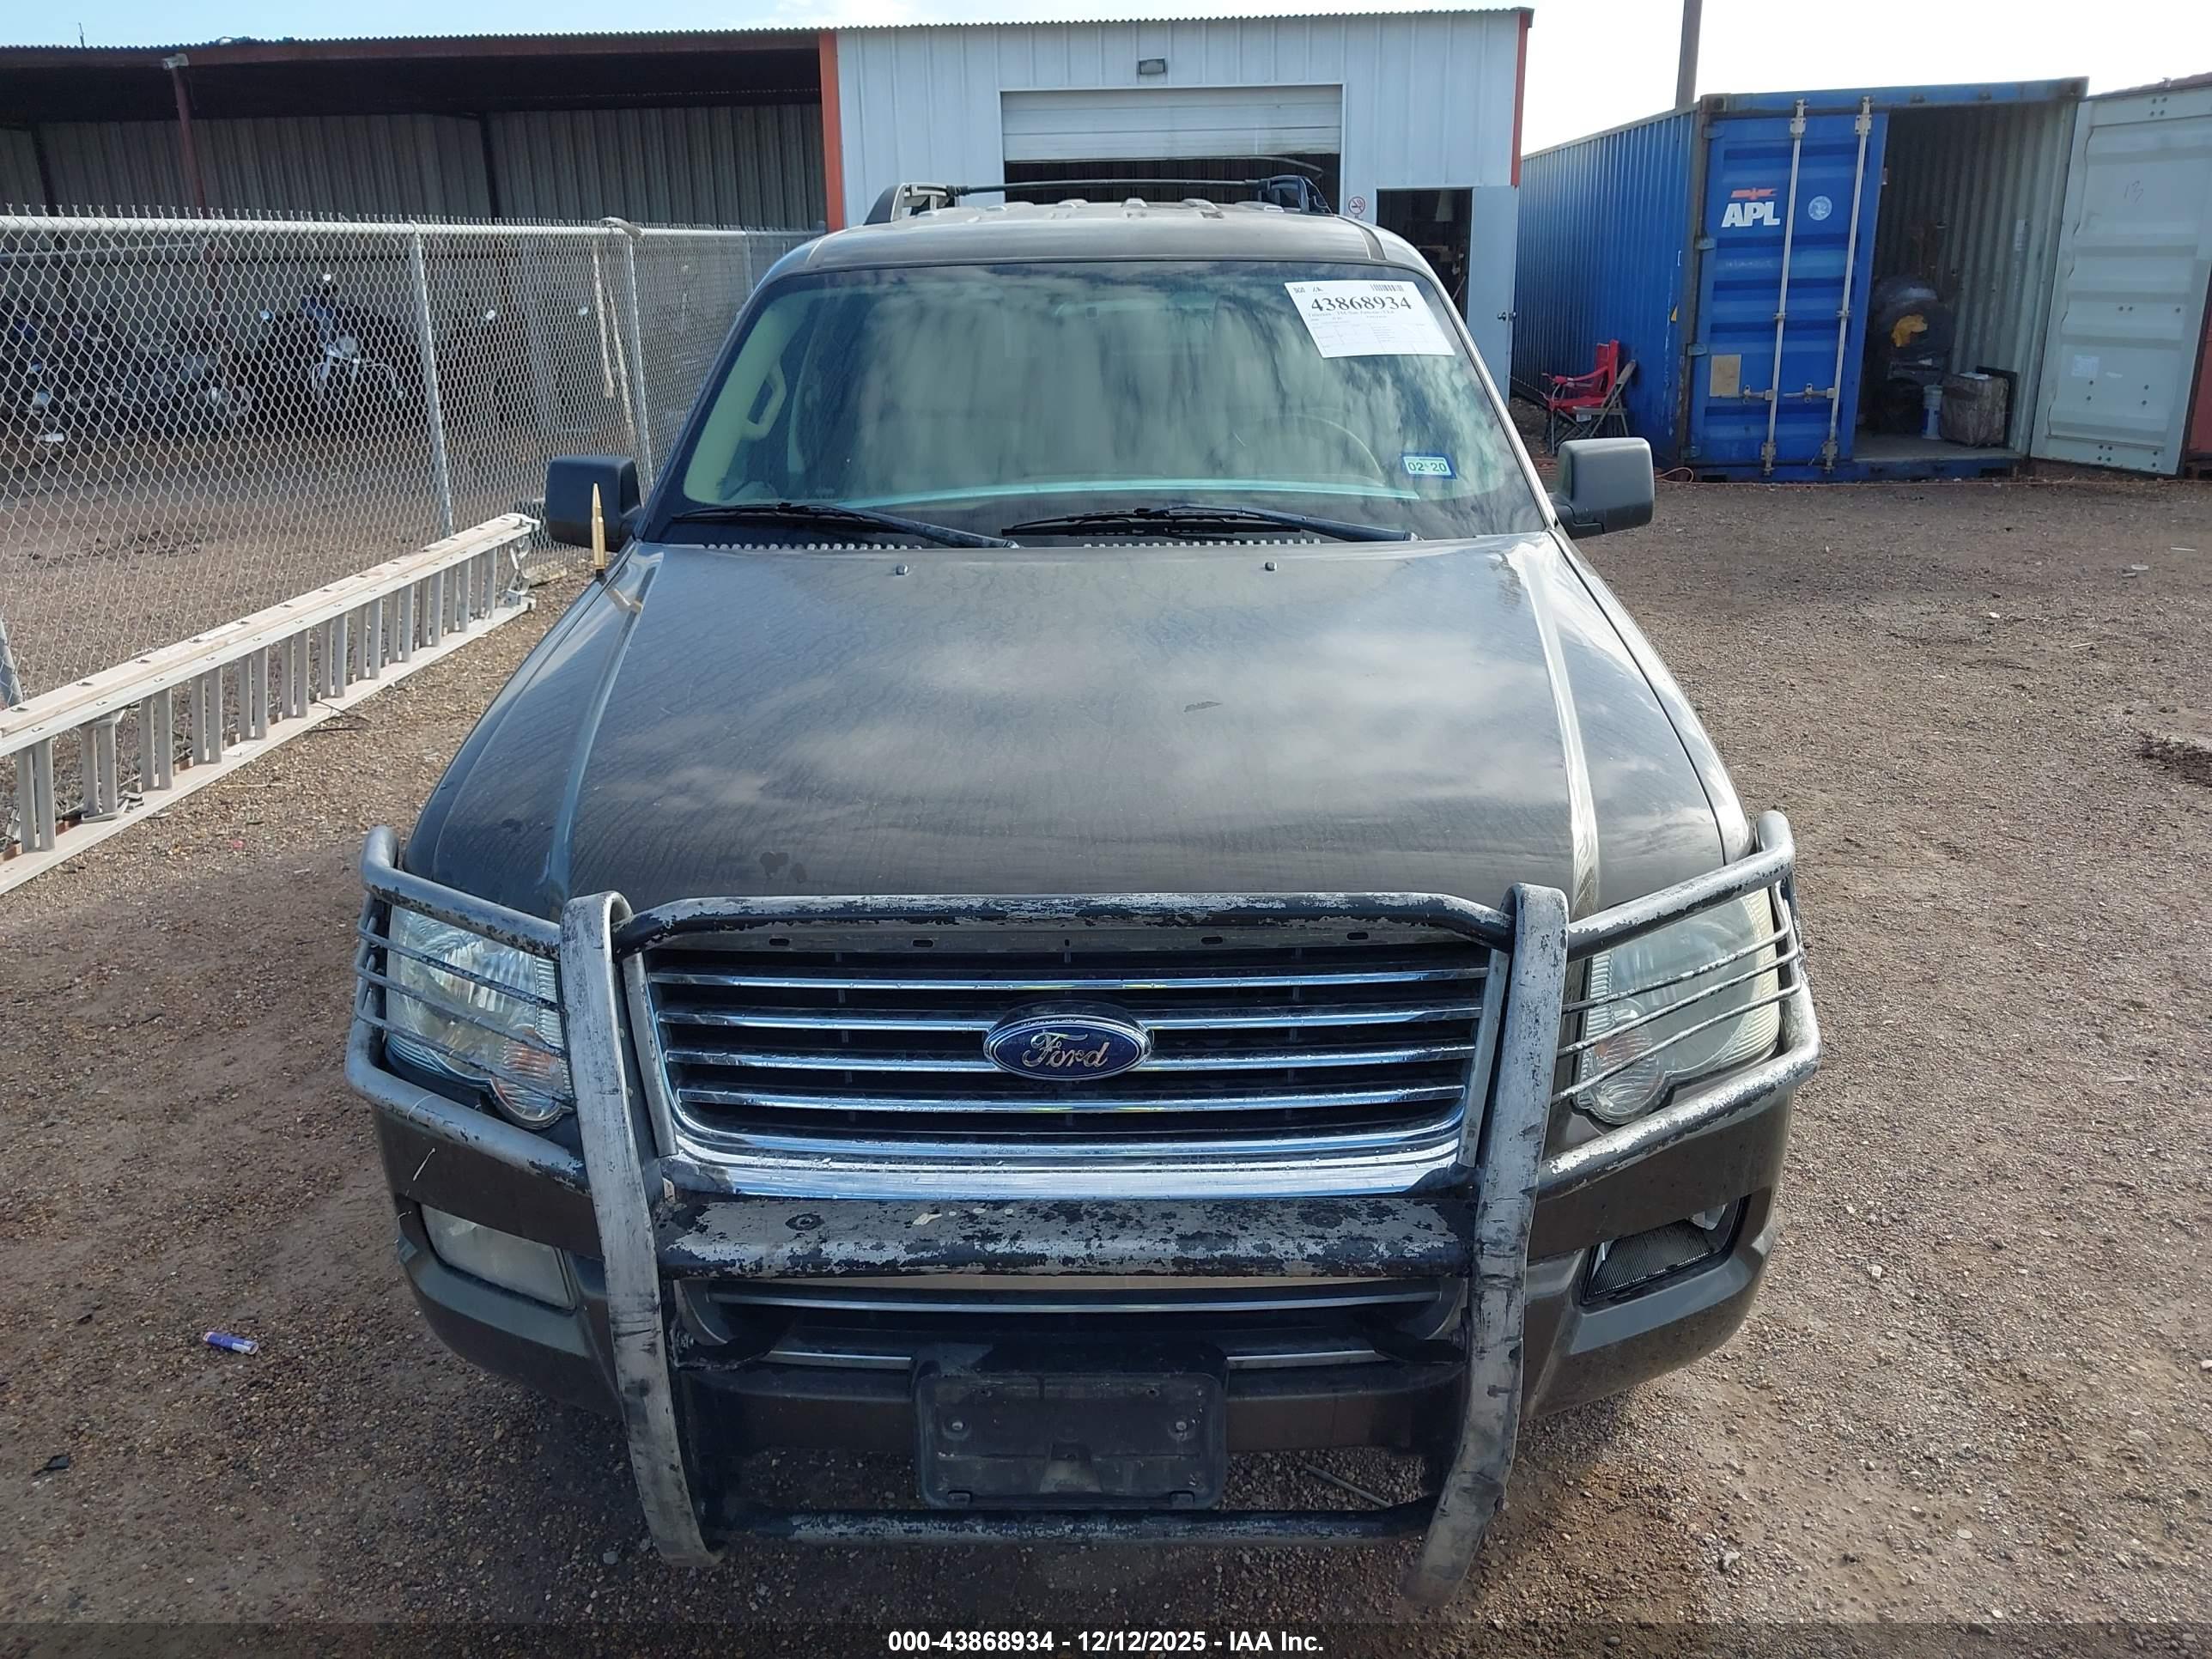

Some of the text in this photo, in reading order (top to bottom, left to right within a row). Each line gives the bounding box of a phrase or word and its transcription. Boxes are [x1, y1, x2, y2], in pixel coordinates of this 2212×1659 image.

[1721, 201, 1781, 228] APL
[1310, 296, 1413, 312] 43868934
[1407, 461, 1448, 472] 02 20
[1022, 1030, 1109, 1068] Ford
